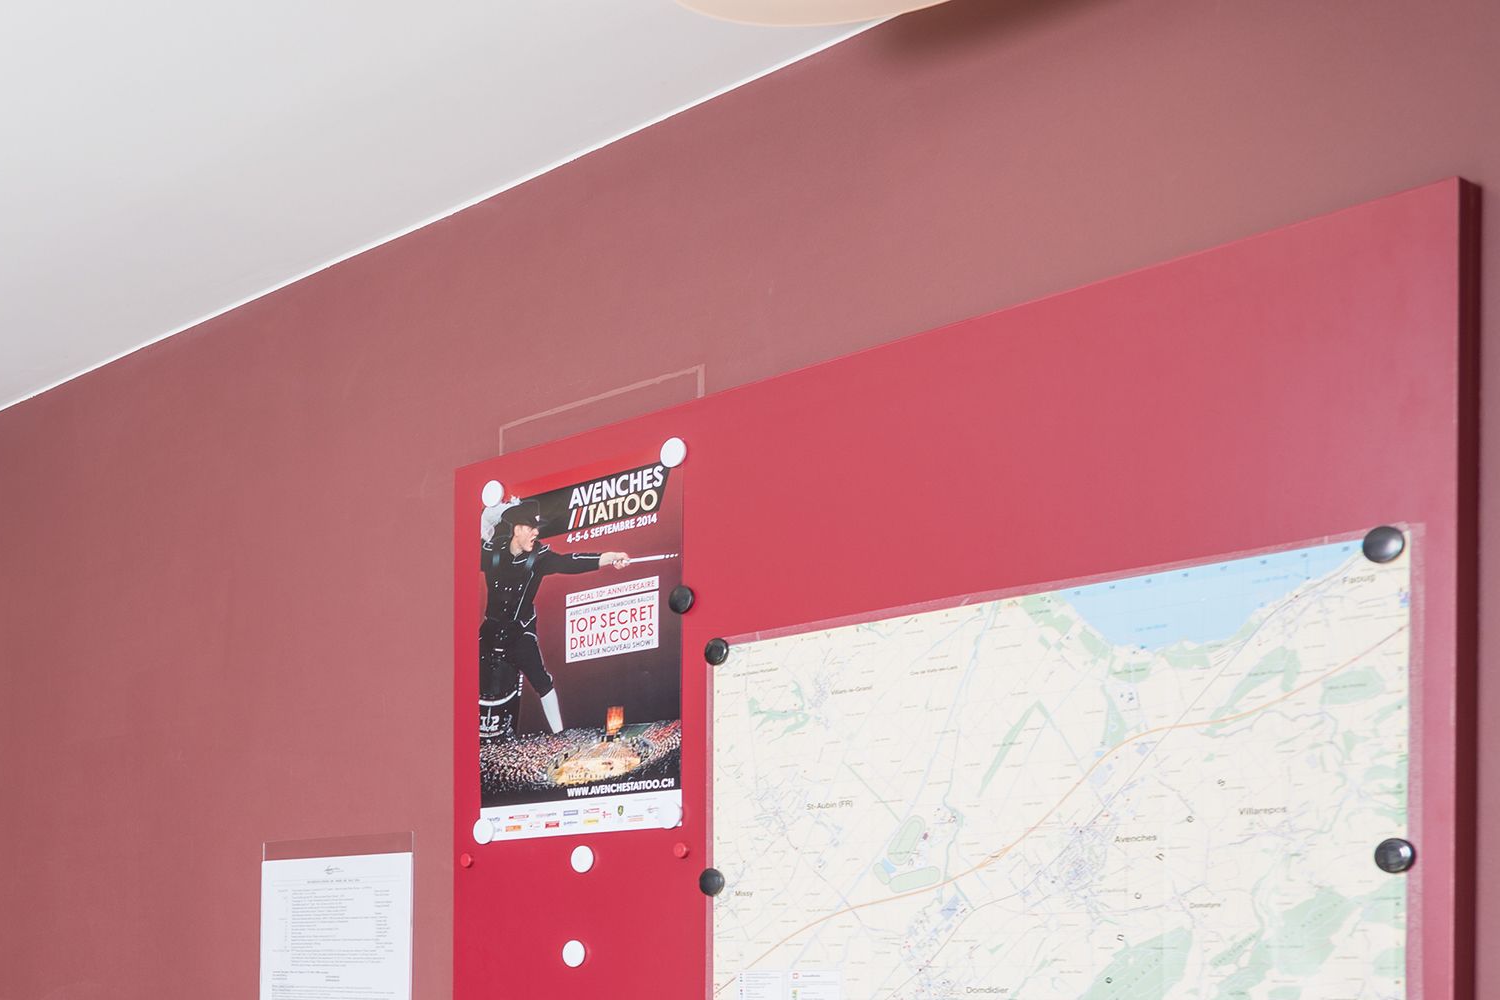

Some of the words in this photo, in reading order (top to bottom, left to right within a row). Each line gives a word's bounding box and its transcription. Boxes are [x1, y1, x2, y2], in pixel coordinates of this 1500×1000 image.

[568, 465, 664, 510] AVENCHES
[566, 530, 589, 543] 4-5-6
[590, 518, 635, 539] SEPTEMBRE
[636, 513, 658, 527] 2014
[607, 580, 655, 595] ANNIVERSAIRE
[570, 615, 597, 634] TOP
[600, 604, 654, 628] SECRET
[570, 631, 607, 650] DRUM
[609, 623, 654, 643] CORPS
[570, 650, 586, 659] DANS
[587, 647, 601, 656] LEUR
[601, 643, 631, 653] NOUVEAU
[566, 777, 675, 798] WWW.AVENCHESTATTOO.CH
[806, 801, 838, 811] St-Aubin
[1114, 834, 1157, 843] Avenches
[965, 986, 1009, 994] Domdidier
